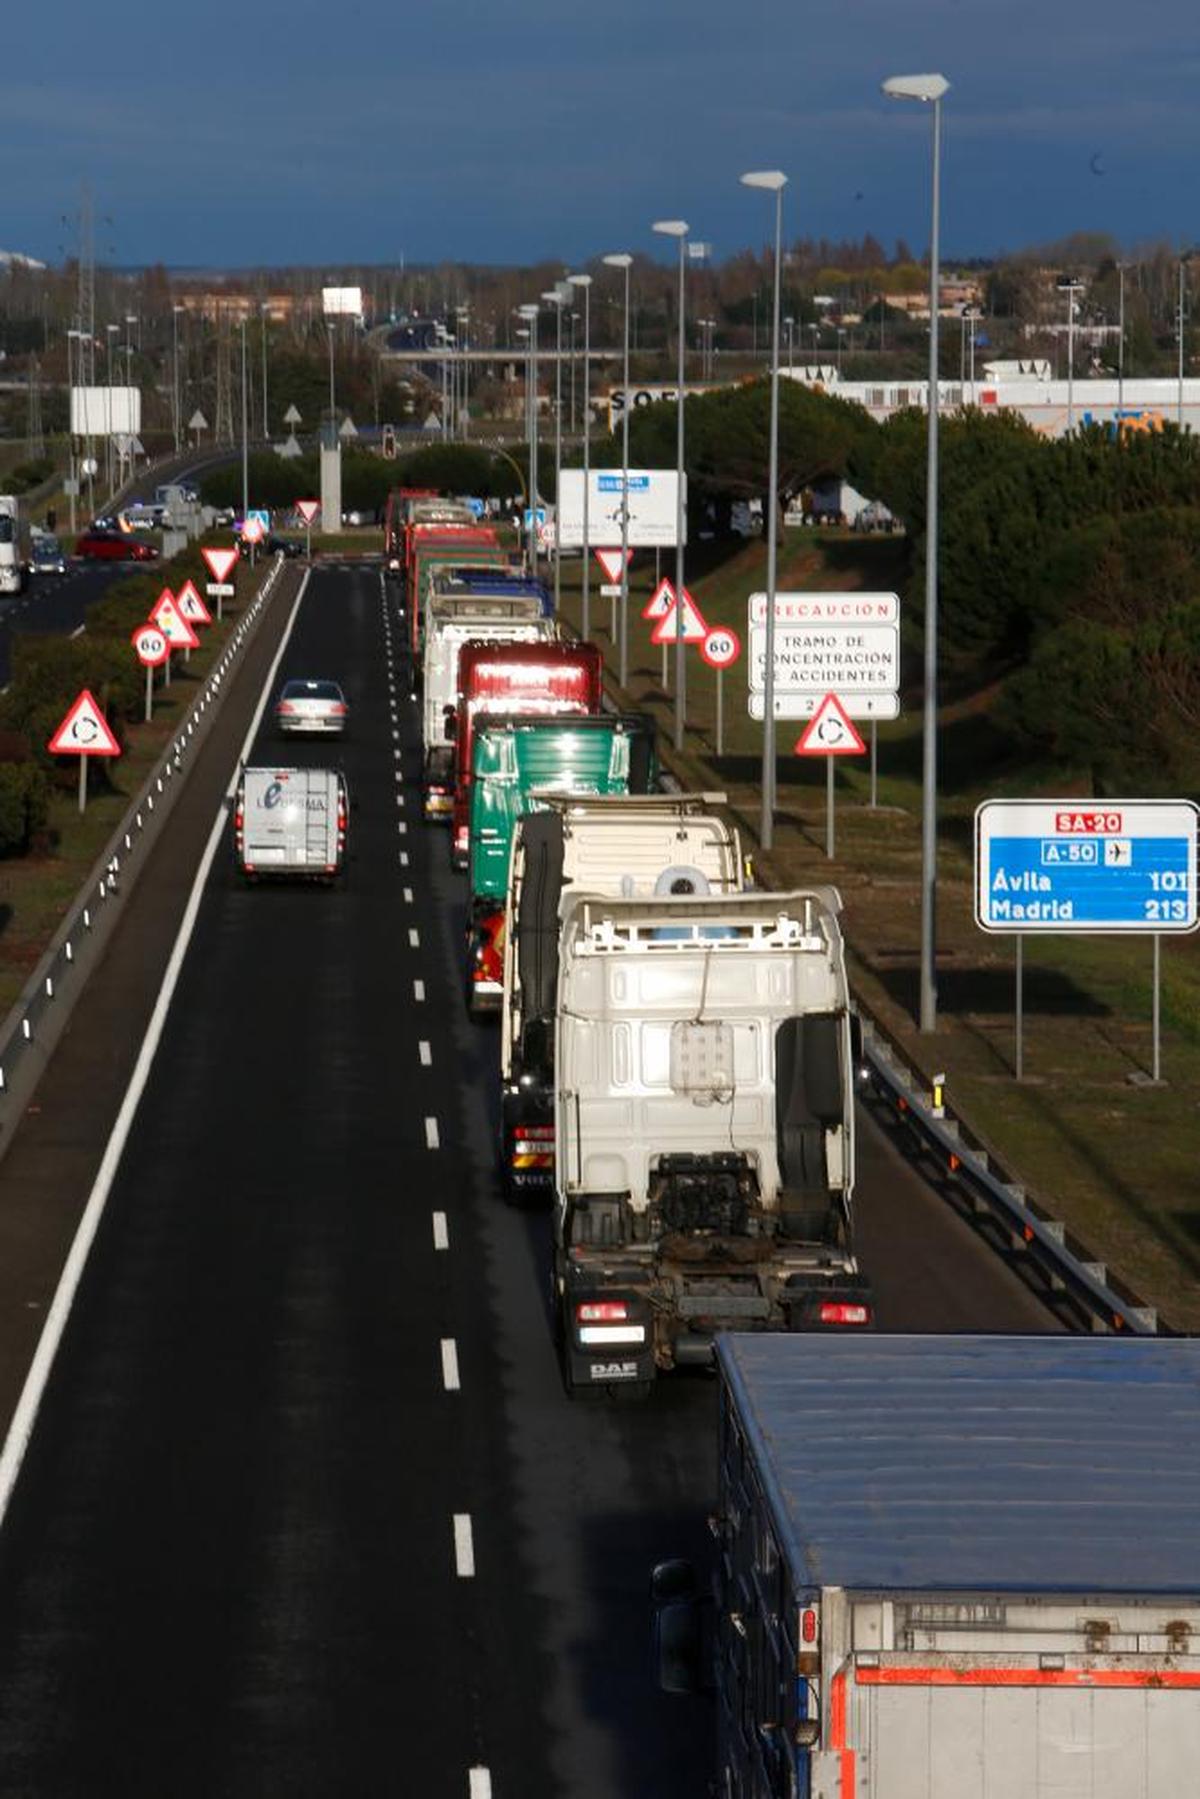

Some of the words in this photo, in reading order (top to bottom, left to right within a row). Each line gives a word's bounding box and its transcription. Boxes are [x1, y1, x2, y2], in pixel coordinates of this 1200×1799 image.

[141, 638, 161, 652] 60
[709, 640, 730, 653] 60
[784, 636, 837, 648] TRAMO
[846, 636, 865, 648] DE
[791, 670, 888, 682] ACCIDENTES
[1058, 814, 1120, 833] SA-20
[1046, 844, 1094, 862] A-50
[992, 868, 1052, 892] Ávila
[1149, 872, 1188, 892] 101
[991, 899, 1074, 920] Madrid
[1145, 900, 1186, 920] 213
[590, 1362, 638, 1376] DAF
